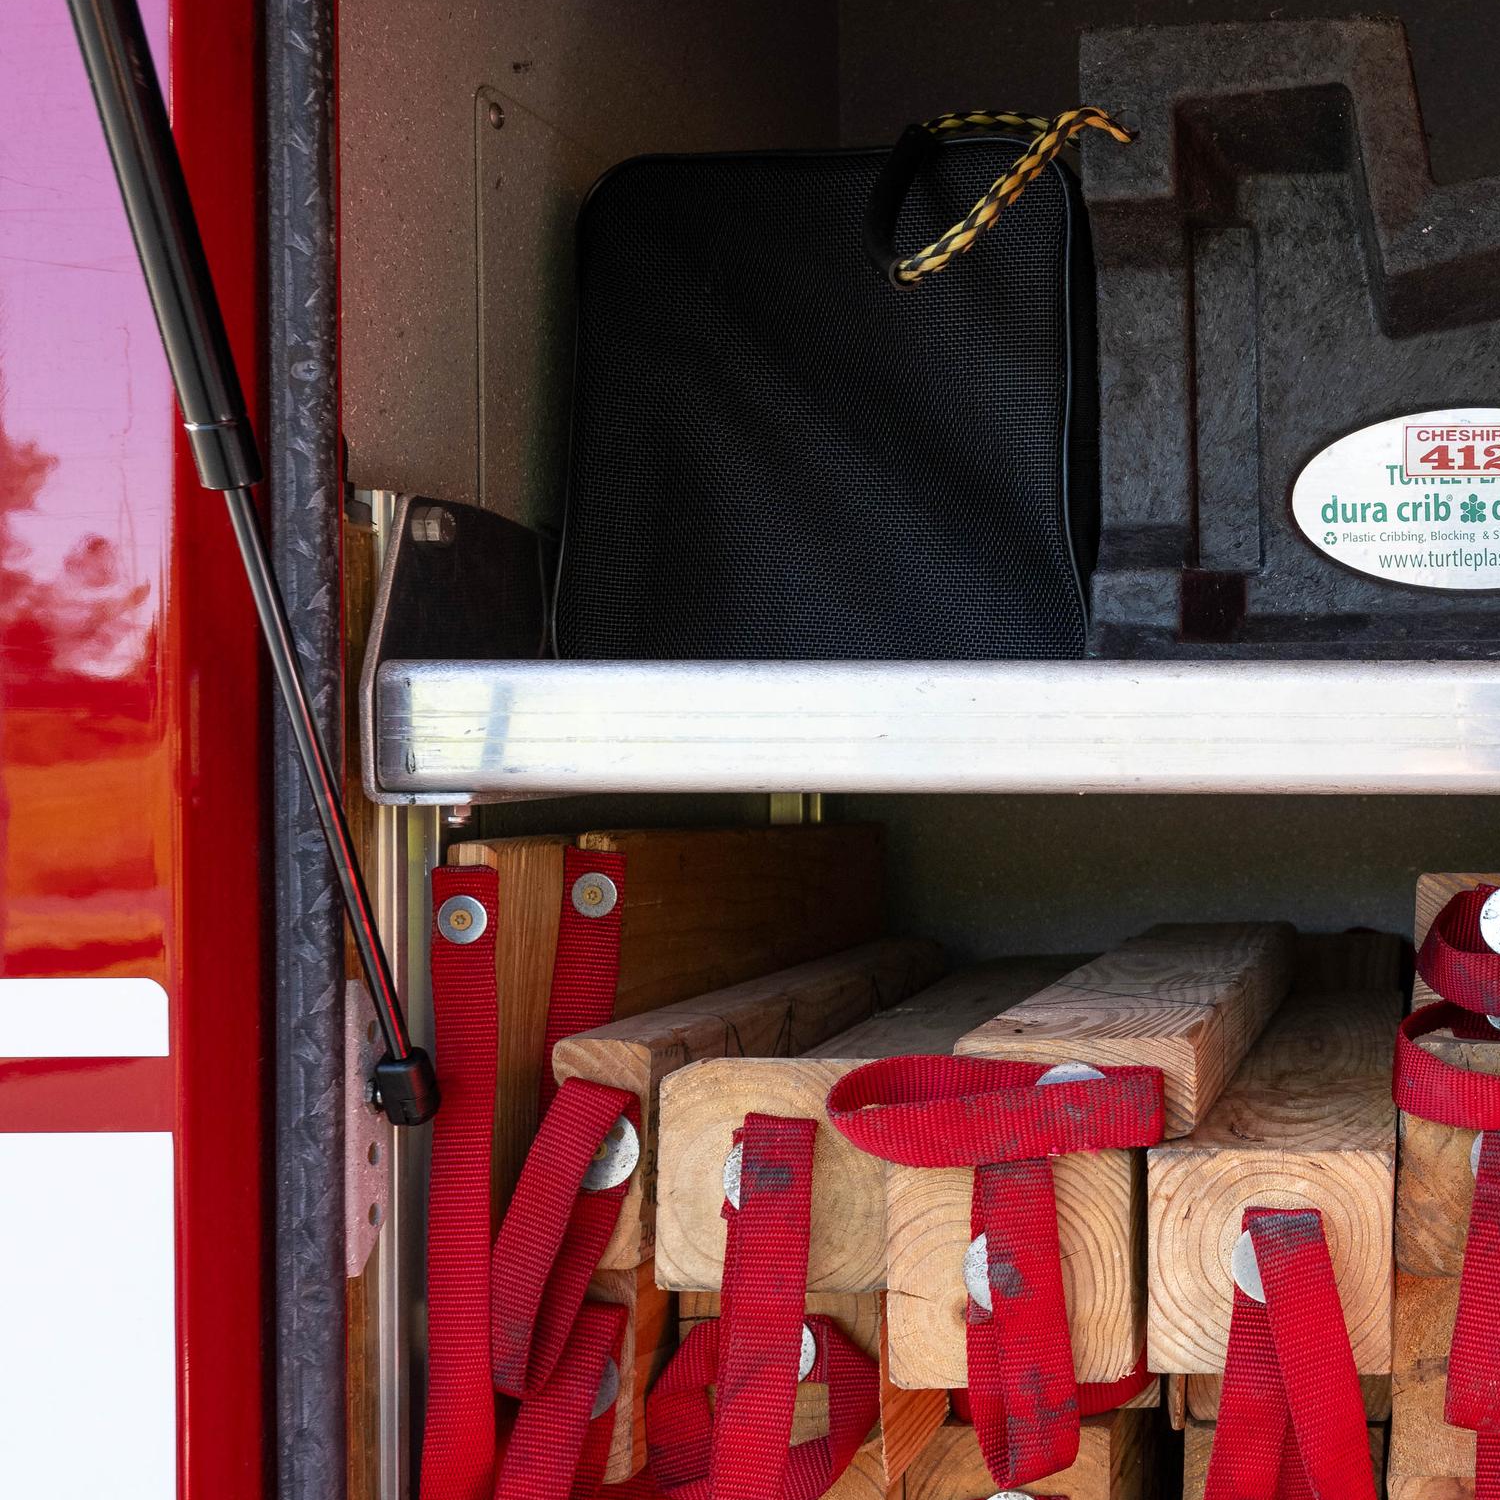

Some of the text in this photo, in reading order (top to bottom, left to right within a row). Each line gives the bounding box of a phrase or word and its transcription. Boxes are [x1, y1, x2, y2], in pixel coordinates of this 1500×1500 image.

[1321, 495, 1388, 524] dura
[1342, 532, 1376, 542] Plastic
[1379, 531, 1427, 544] Cribbing,
[1430, 530, 1476, 543] Blocking
[1482, 530, 1490, 540] &
